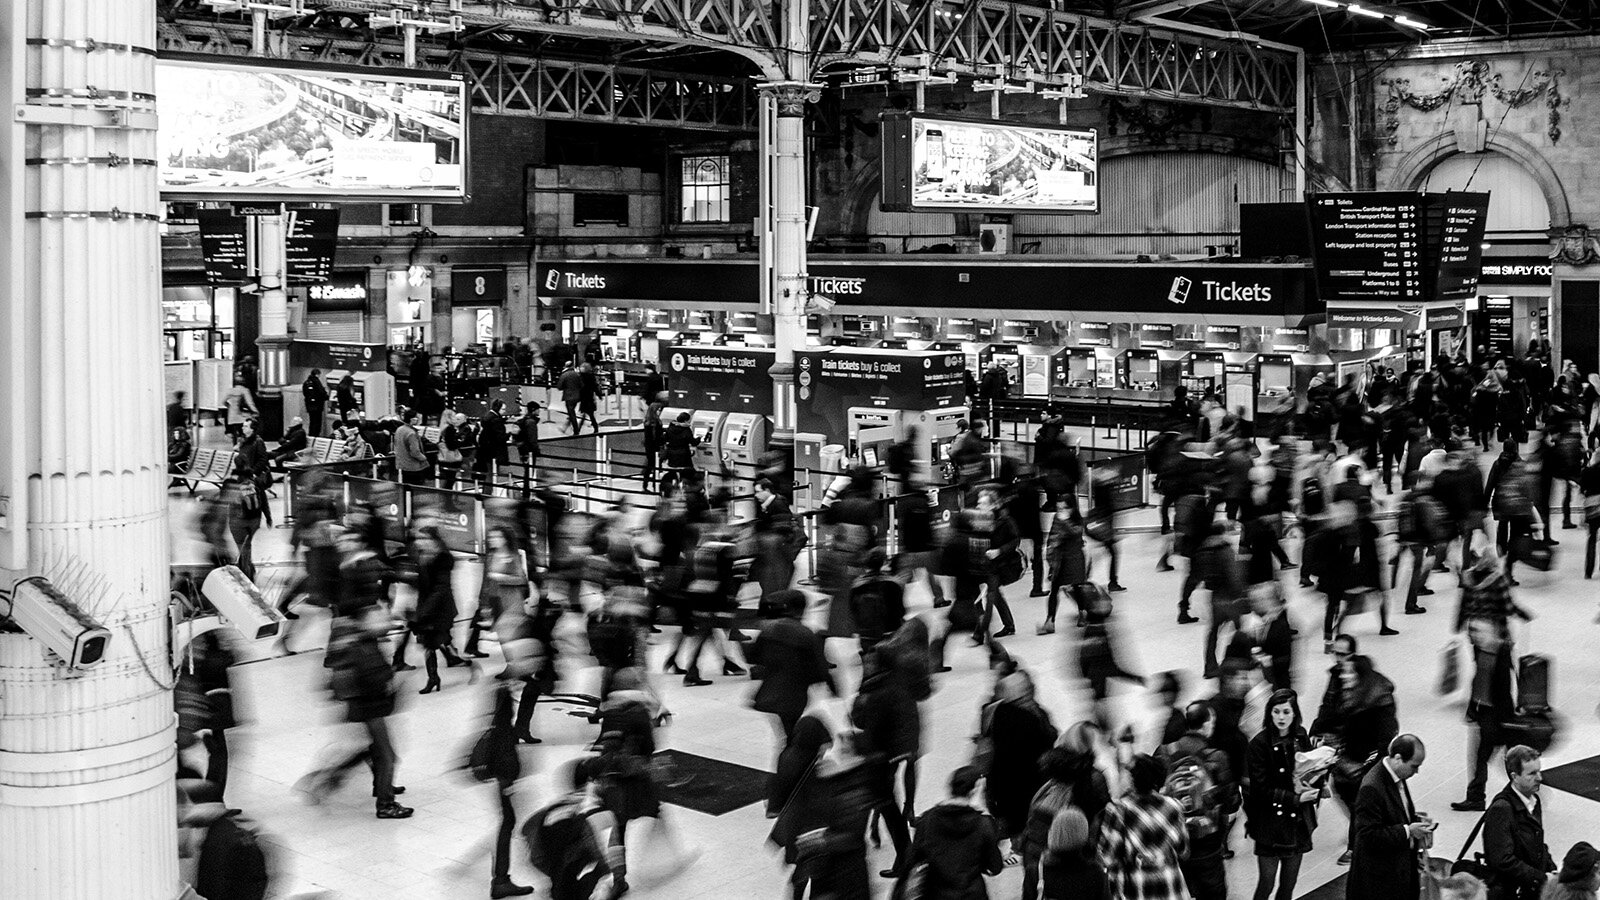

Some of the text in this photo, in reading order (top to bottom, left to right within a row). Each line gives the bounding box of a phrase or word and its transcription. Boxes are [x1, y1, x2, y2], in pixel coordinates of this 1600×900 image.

[1345, 223, 1367, 231] Transport
[1502, 265, 1533, 275] SIMPLY
[565, 272, 607, 289] Tickets
[322, 284, 366, 299] iSmash
[1202, 281, 1272, 302] Tickets
[1363, 315, 1383, 323] Victoria
[687, 354, 756, 367] Train tickets buy & collect
[821, 359, 901, 373] Train tickets buy & collect
